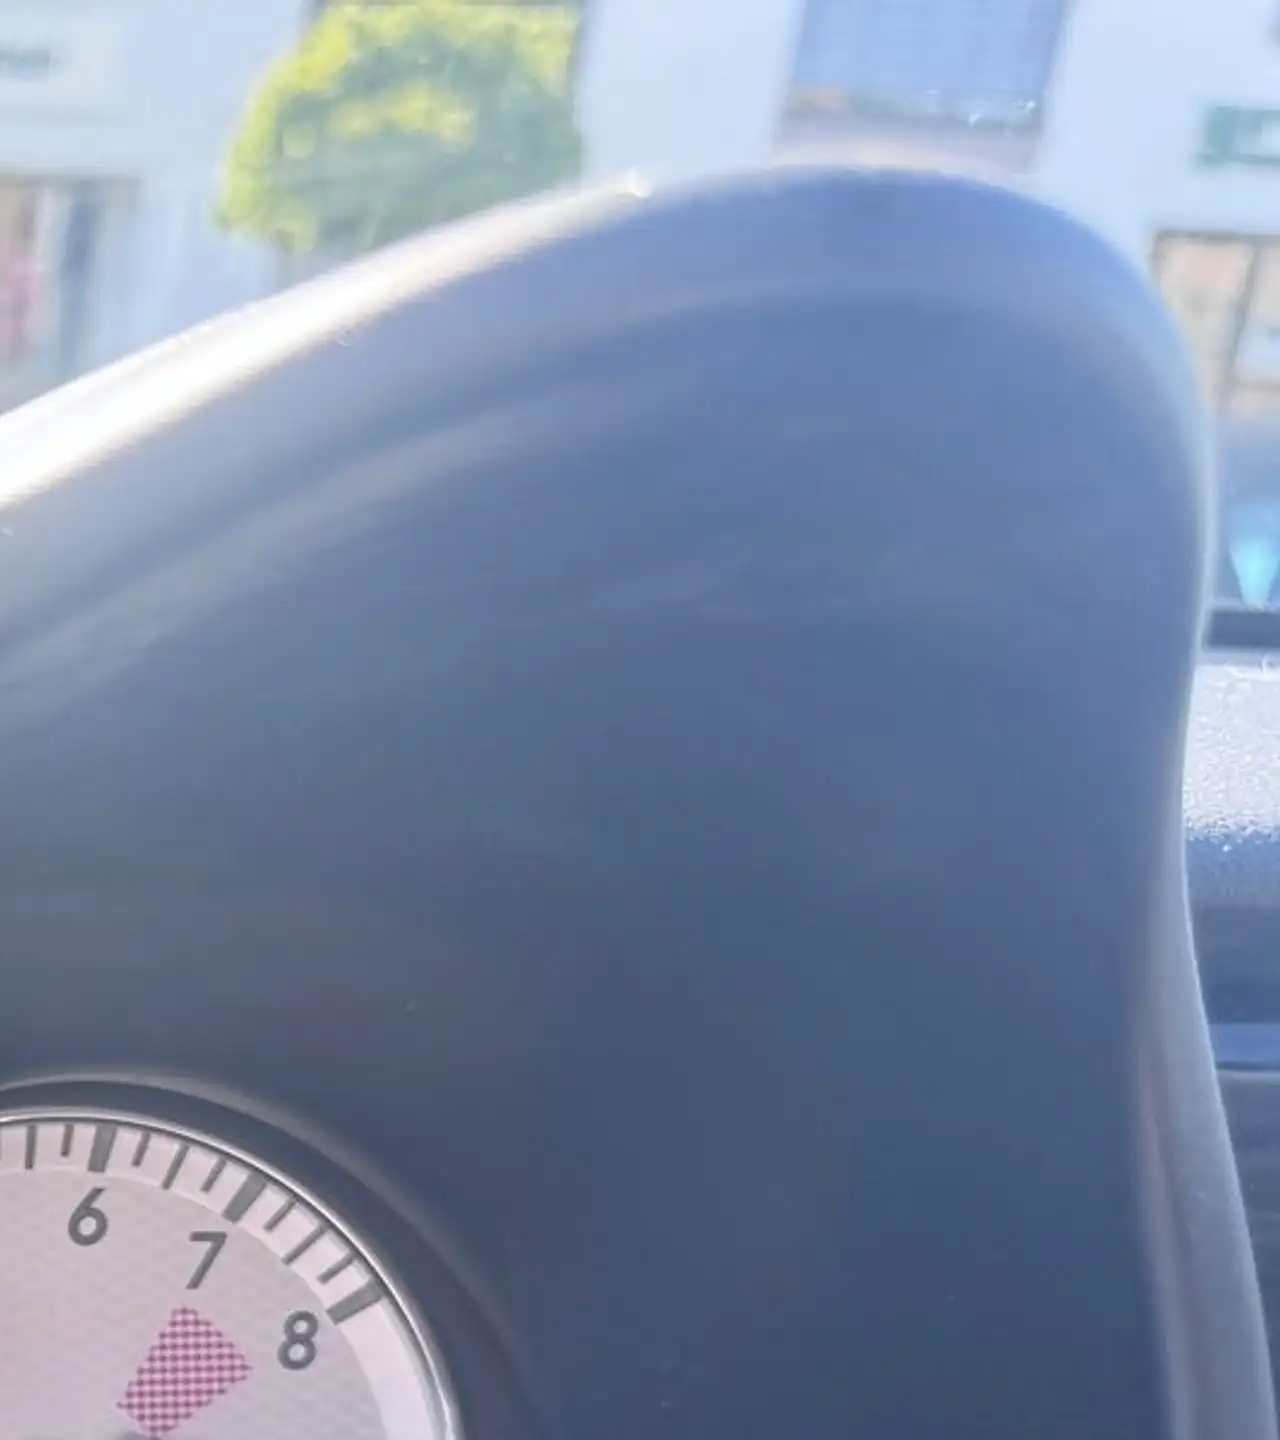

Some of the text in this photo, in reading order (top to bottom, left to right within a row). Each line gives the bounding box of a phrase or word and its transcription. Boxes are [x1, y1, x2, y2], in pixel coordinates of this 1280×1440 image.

[67, 1187, 109, 1247] 6
[186, 1230, 228, 1290] 7
[277, 1310, 319, 1371] 8
